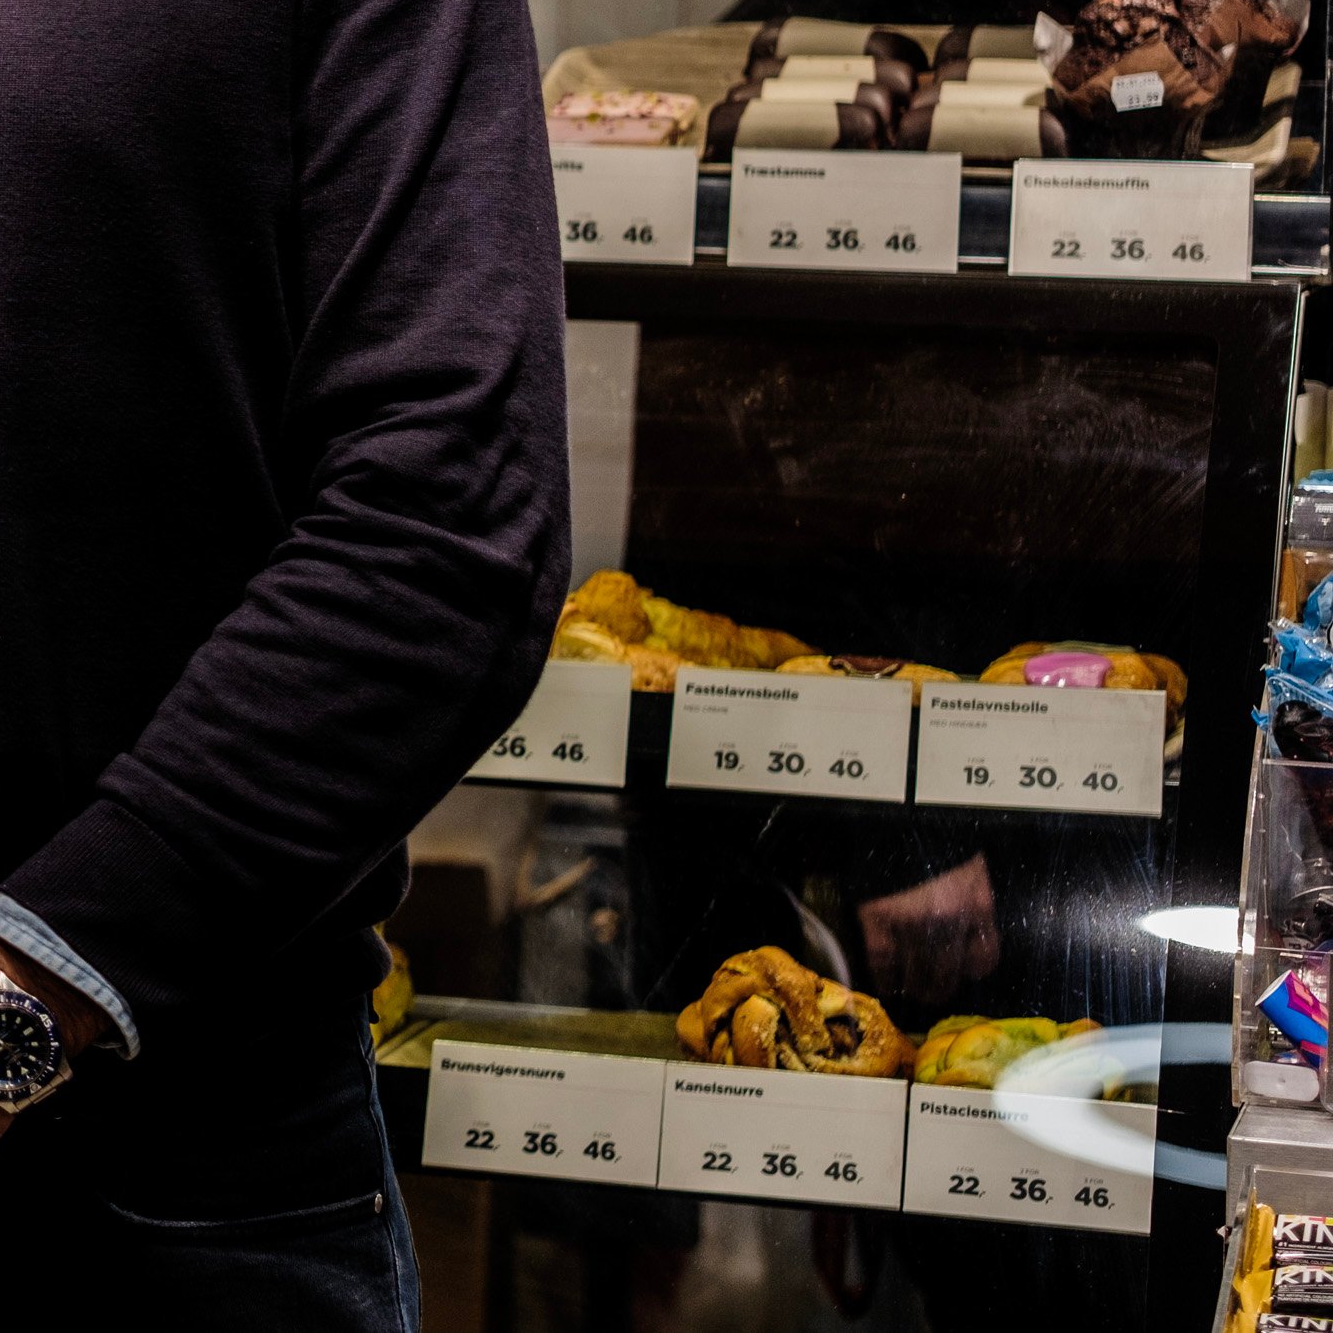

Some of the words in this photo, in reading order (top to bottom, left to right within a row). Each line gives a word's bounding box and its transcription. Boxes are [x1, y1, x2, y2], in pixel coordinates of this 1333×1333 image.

[1024, 175, 1150, 190] Chokolademuffin
[685, 682, 799, 701] Fastelavnsbolle
[931, 697, 1049, 715] Fastelavnsbolle
[39, 1013, 53, 1029] 45
[441, 1057, 565, 1081] Brunsvigersnurre
[675, 1079, 764, 1098] Kanelsnurre
[920, 1101, 1030, 1122] Pistaciesnurre
